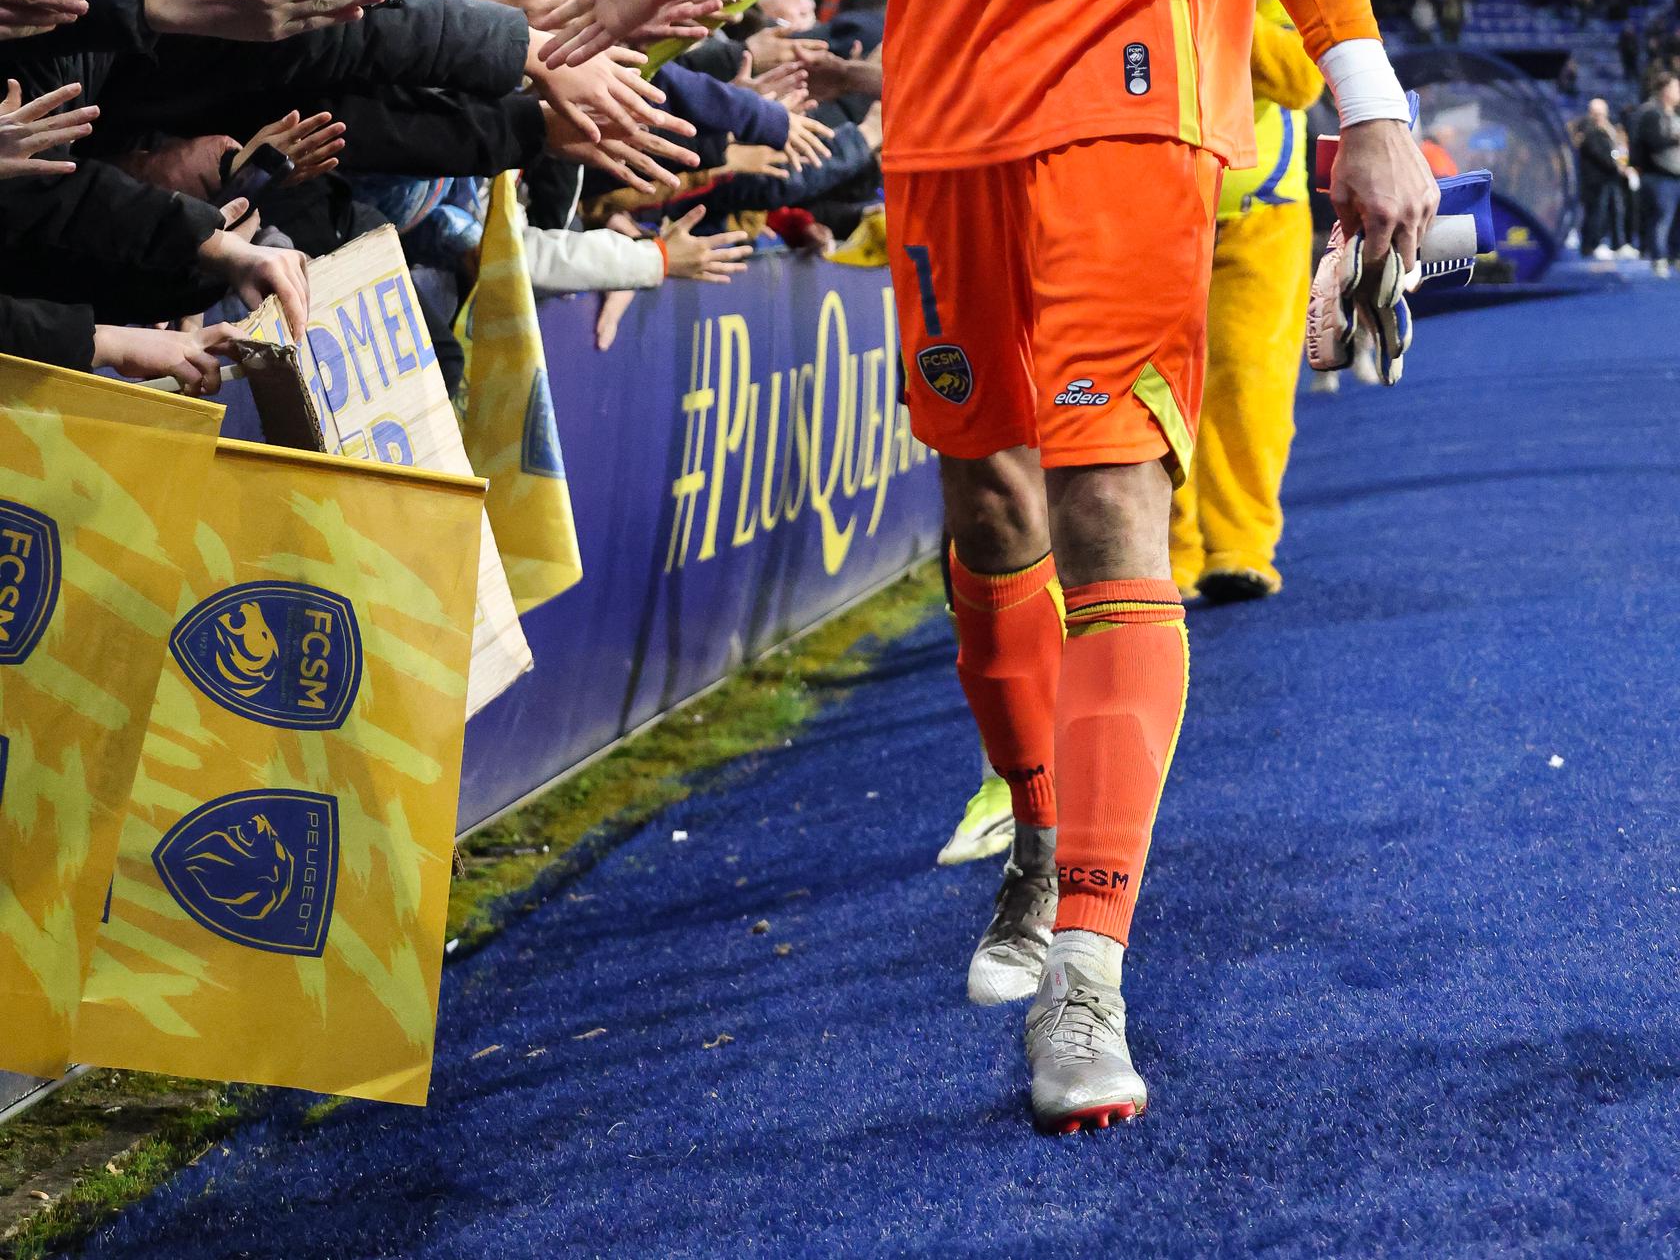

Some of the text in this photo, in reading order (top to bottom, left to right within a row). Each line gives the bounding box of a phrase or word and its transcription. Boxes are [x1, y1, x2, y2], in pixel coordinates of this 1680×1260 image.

[904, 245, 942, 336] 1
[921, 351, 961, 369] FCSM
[1055, 391, 1110, 405] eldera
[298, 608, 333, 710] FCSM
[296, 811, 319, 937] PEUGEOT
[1058, 867, 1129, 891] FCSM
